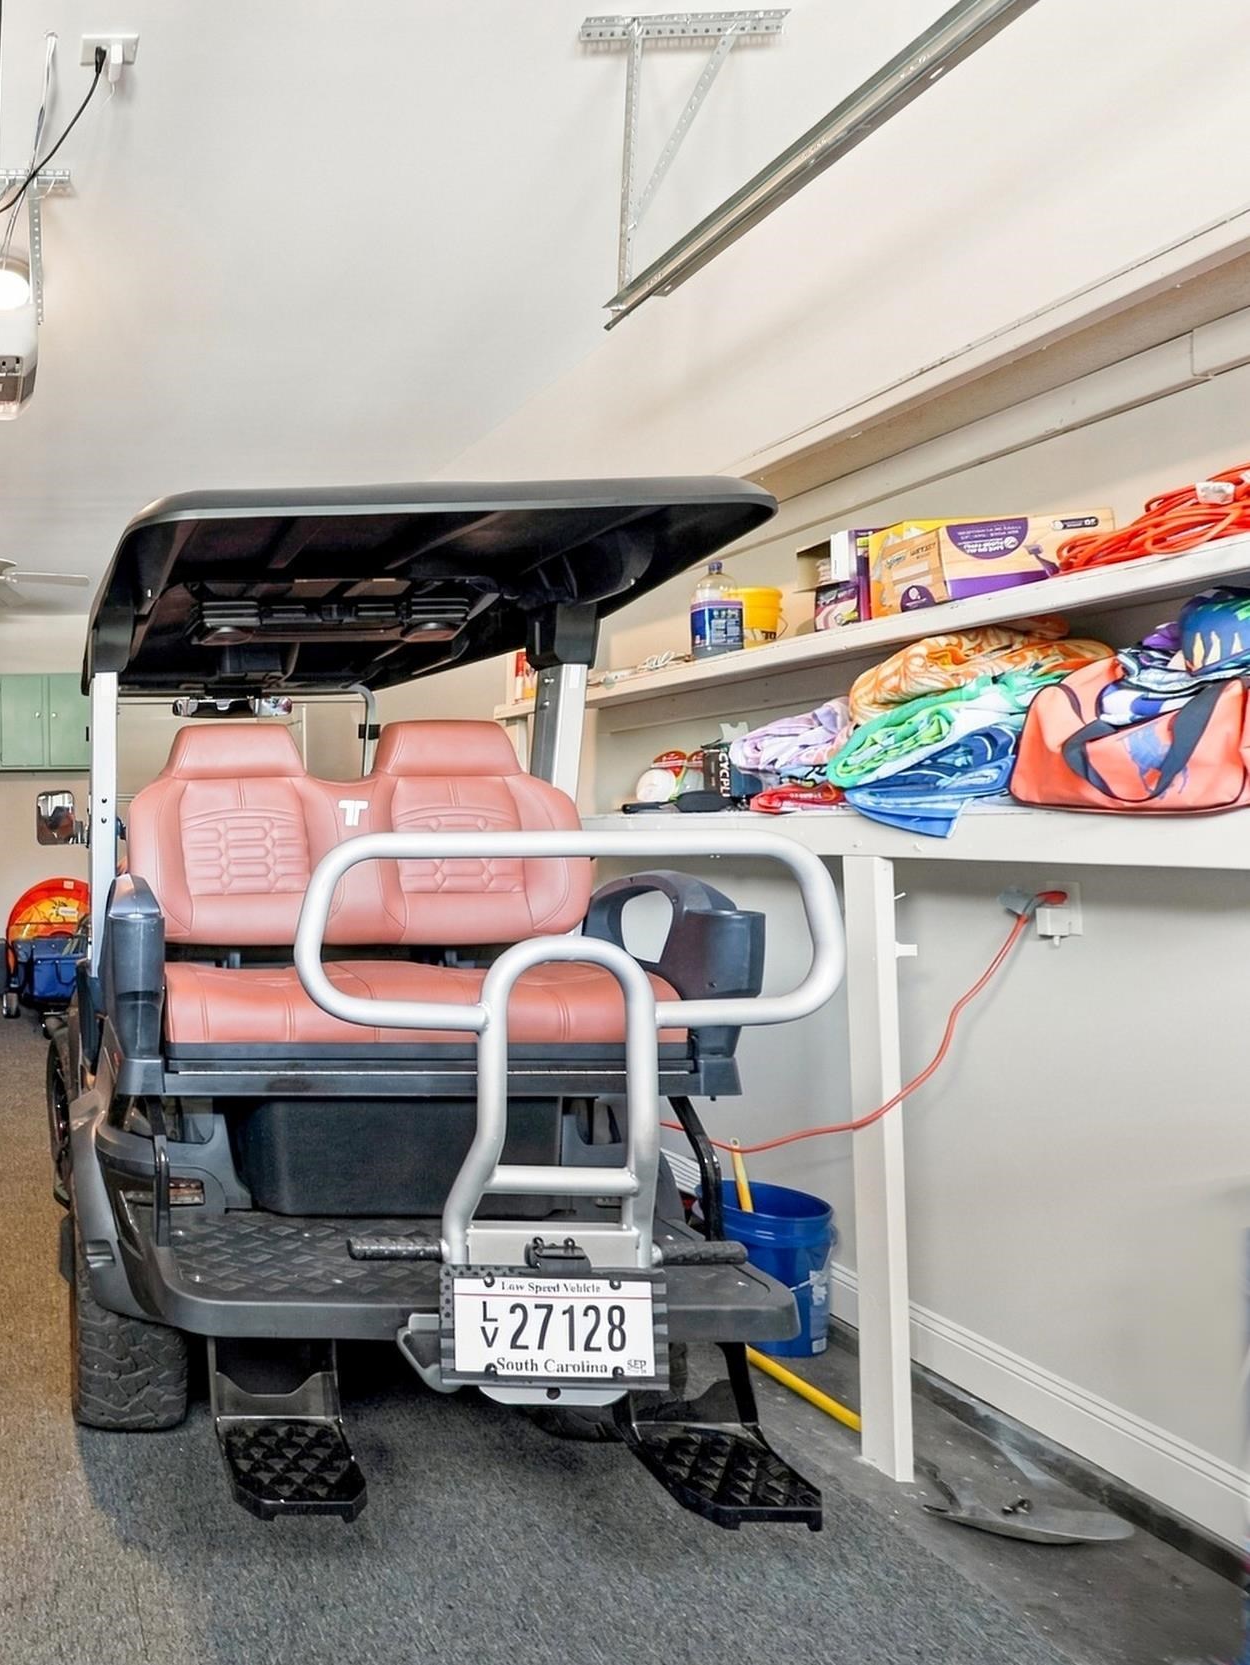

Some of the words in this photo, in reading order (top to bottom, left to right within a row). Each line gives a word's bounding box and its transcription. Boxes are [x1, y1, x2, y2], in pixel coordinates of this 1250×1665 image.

[501, 1281, 524, 1291] Low
[528, 1282, 560, 1294] Speed
[564, 1283, 601, 1293] Vehicle
[509, 1303, 627, 1352] 27128
[496, 1357, 539, 1373] South
[544, 1359, 609, 1374] Carolina
[627, 1359, 647, 1370] SEP
